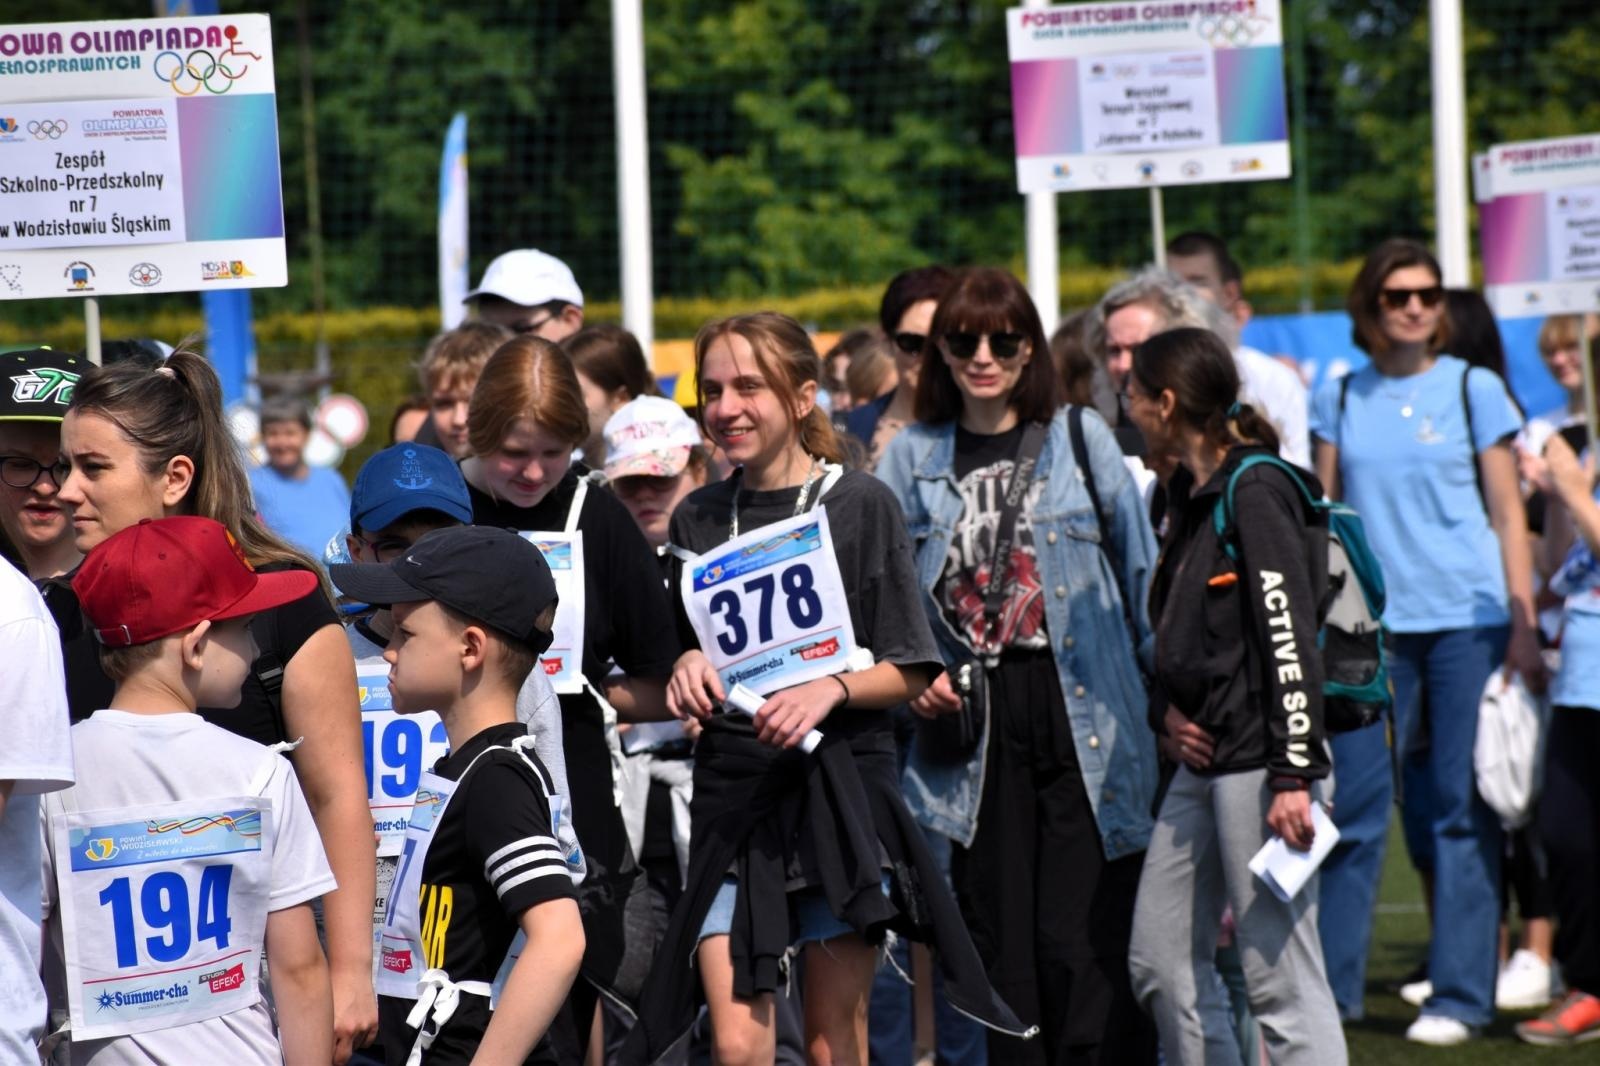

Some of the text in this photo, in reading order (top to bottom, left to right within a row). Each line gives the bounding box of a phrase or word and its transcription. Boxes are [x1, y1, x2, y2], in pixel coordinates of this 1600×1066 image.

[70, 25, 222, 55] OLIMPIADA
[82, 117, 168, 132] OLIMPIADA
[113, 109, 164, 118] POWIATOWA
[56, 150, 105, 172] Zespół
[0, 171, 164, 194] Szkolno-Przedszkolny
[69, 195, 97, 213] nr 7
[14, 218, 107, 238] Wodzisławiu
[111, 213, 171, 237] Śląskim
[709, 563, 823, 656] 378
[1259, 569, 1303, 684] ACTIVE
[735, 657, 784, 683] Summer-cha
[99, 864, 234, 968] 194
[384, 956, 407, 968] EFEKT
[201, 971, 226, 981] STUDIO
[212, 973, 240, 990] EFEKT
[114, 982, 189, 1007] Summer-cha
